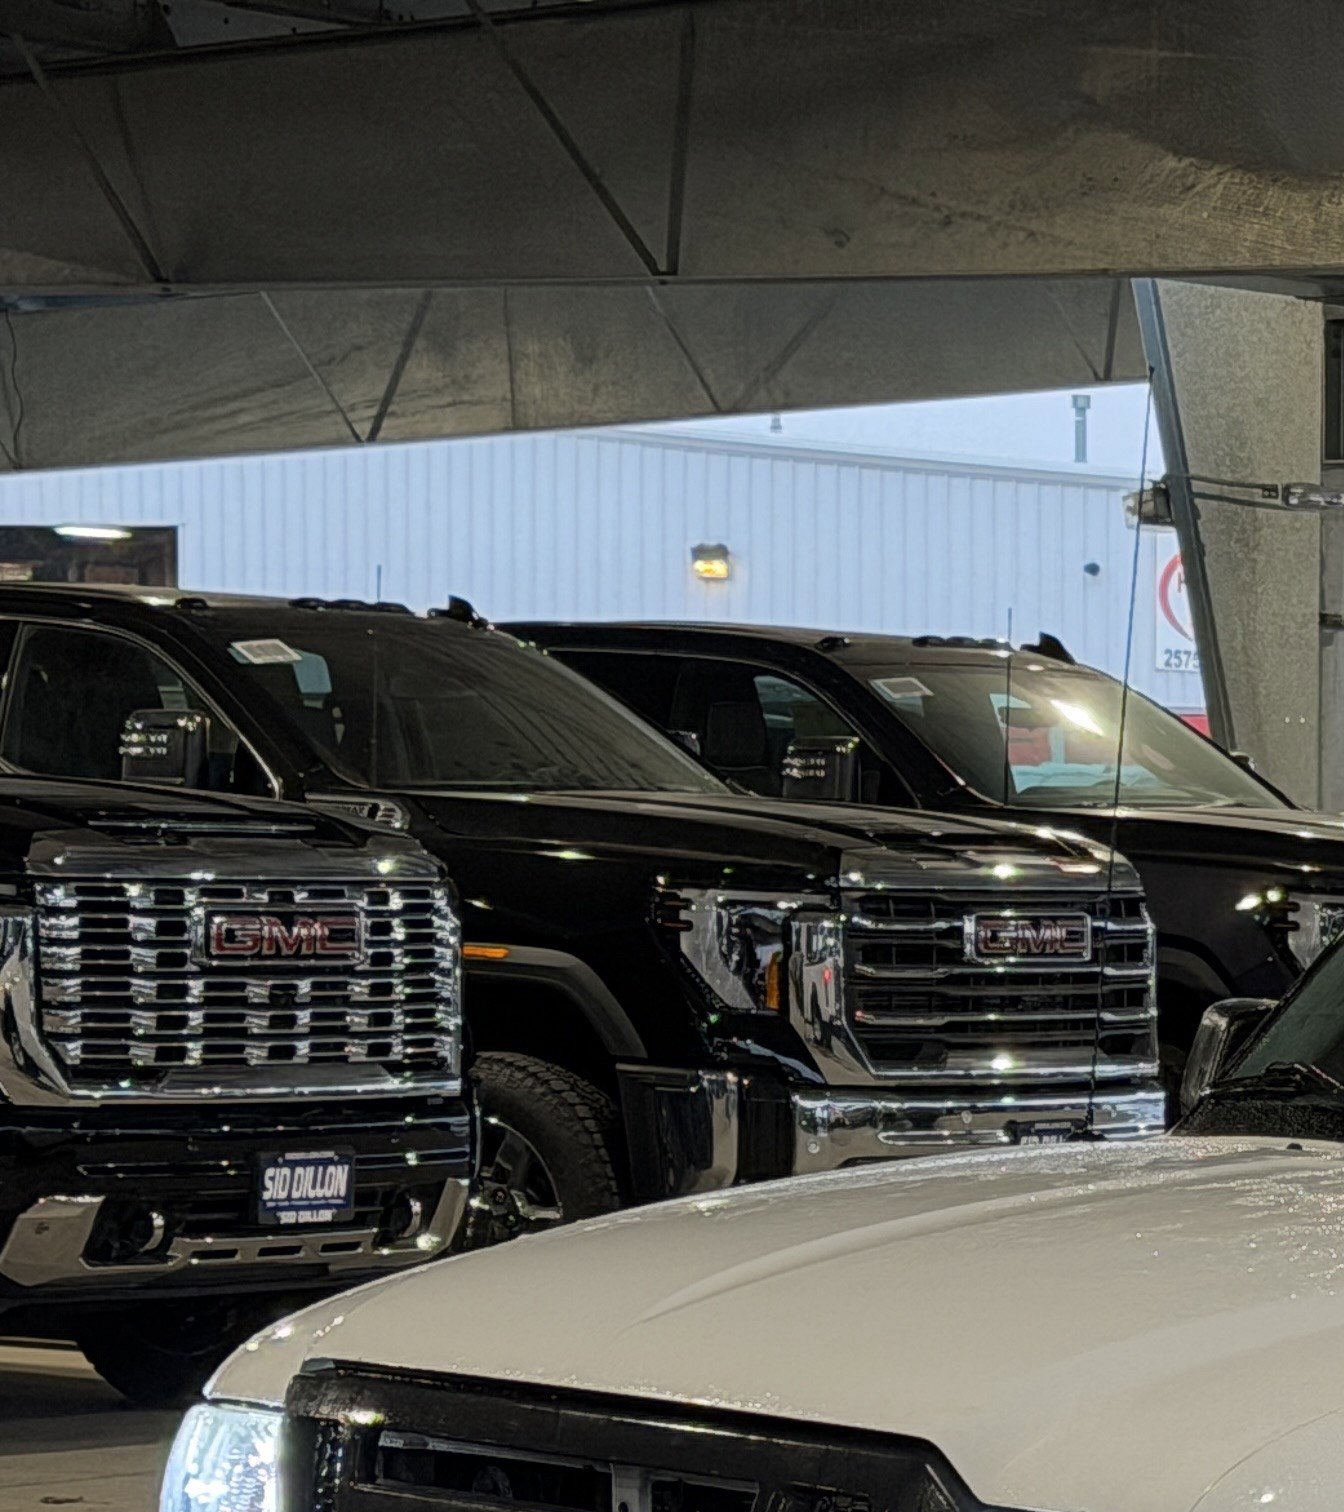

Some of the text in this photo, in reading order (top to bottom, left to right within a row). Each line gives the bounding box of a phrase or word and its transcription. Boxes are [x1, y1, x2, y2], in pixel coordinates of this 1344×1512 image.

[209, 915, 359, 955] GMC
[977, 919, 1088, 953] GMC
[262, 1164, 350, 1200] SID DILLON
